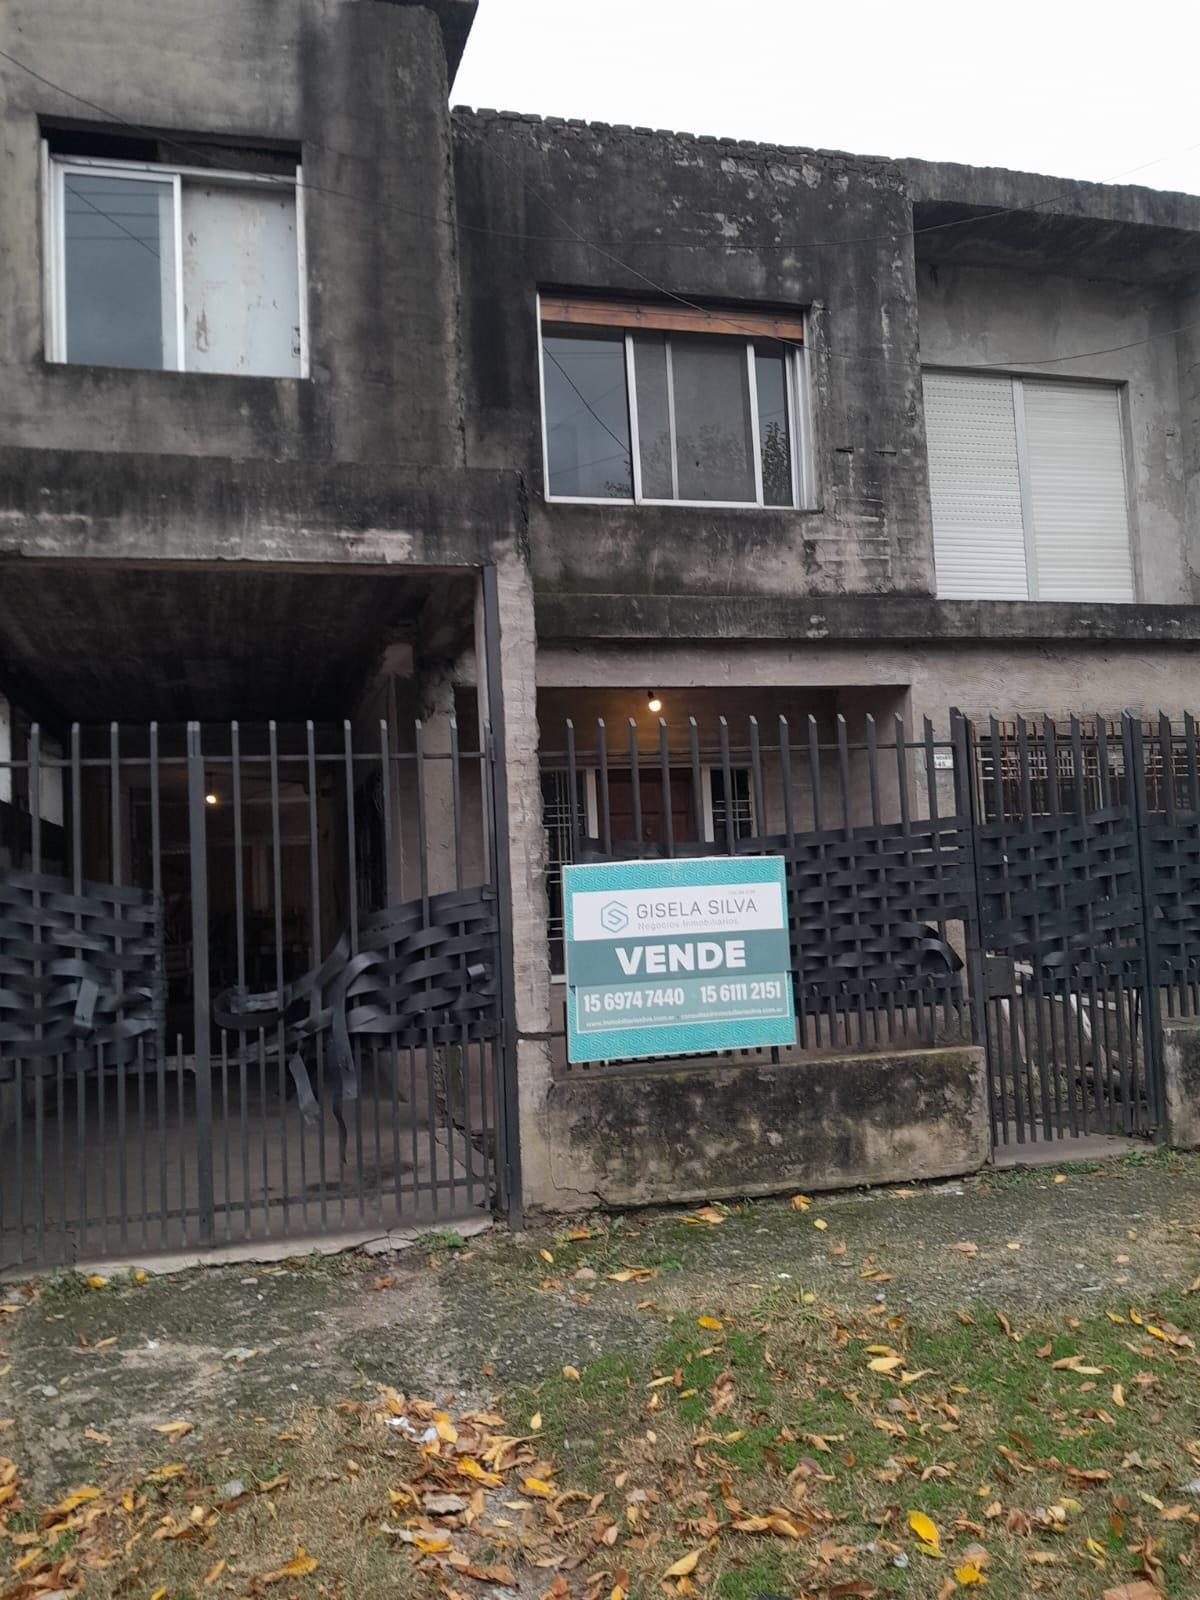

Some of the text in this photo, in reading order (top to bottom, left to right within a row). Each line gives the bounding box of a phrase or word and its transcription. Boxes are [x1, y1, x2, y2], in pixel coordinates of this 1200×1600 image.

[636, 897, 758, 919] GISELA SILVA
[614, 940, 747, 976] VENDE
[584, 987, 685, 1012] 15 6974 7440
[701, 981, 781, 1003] 15 6111 2151
